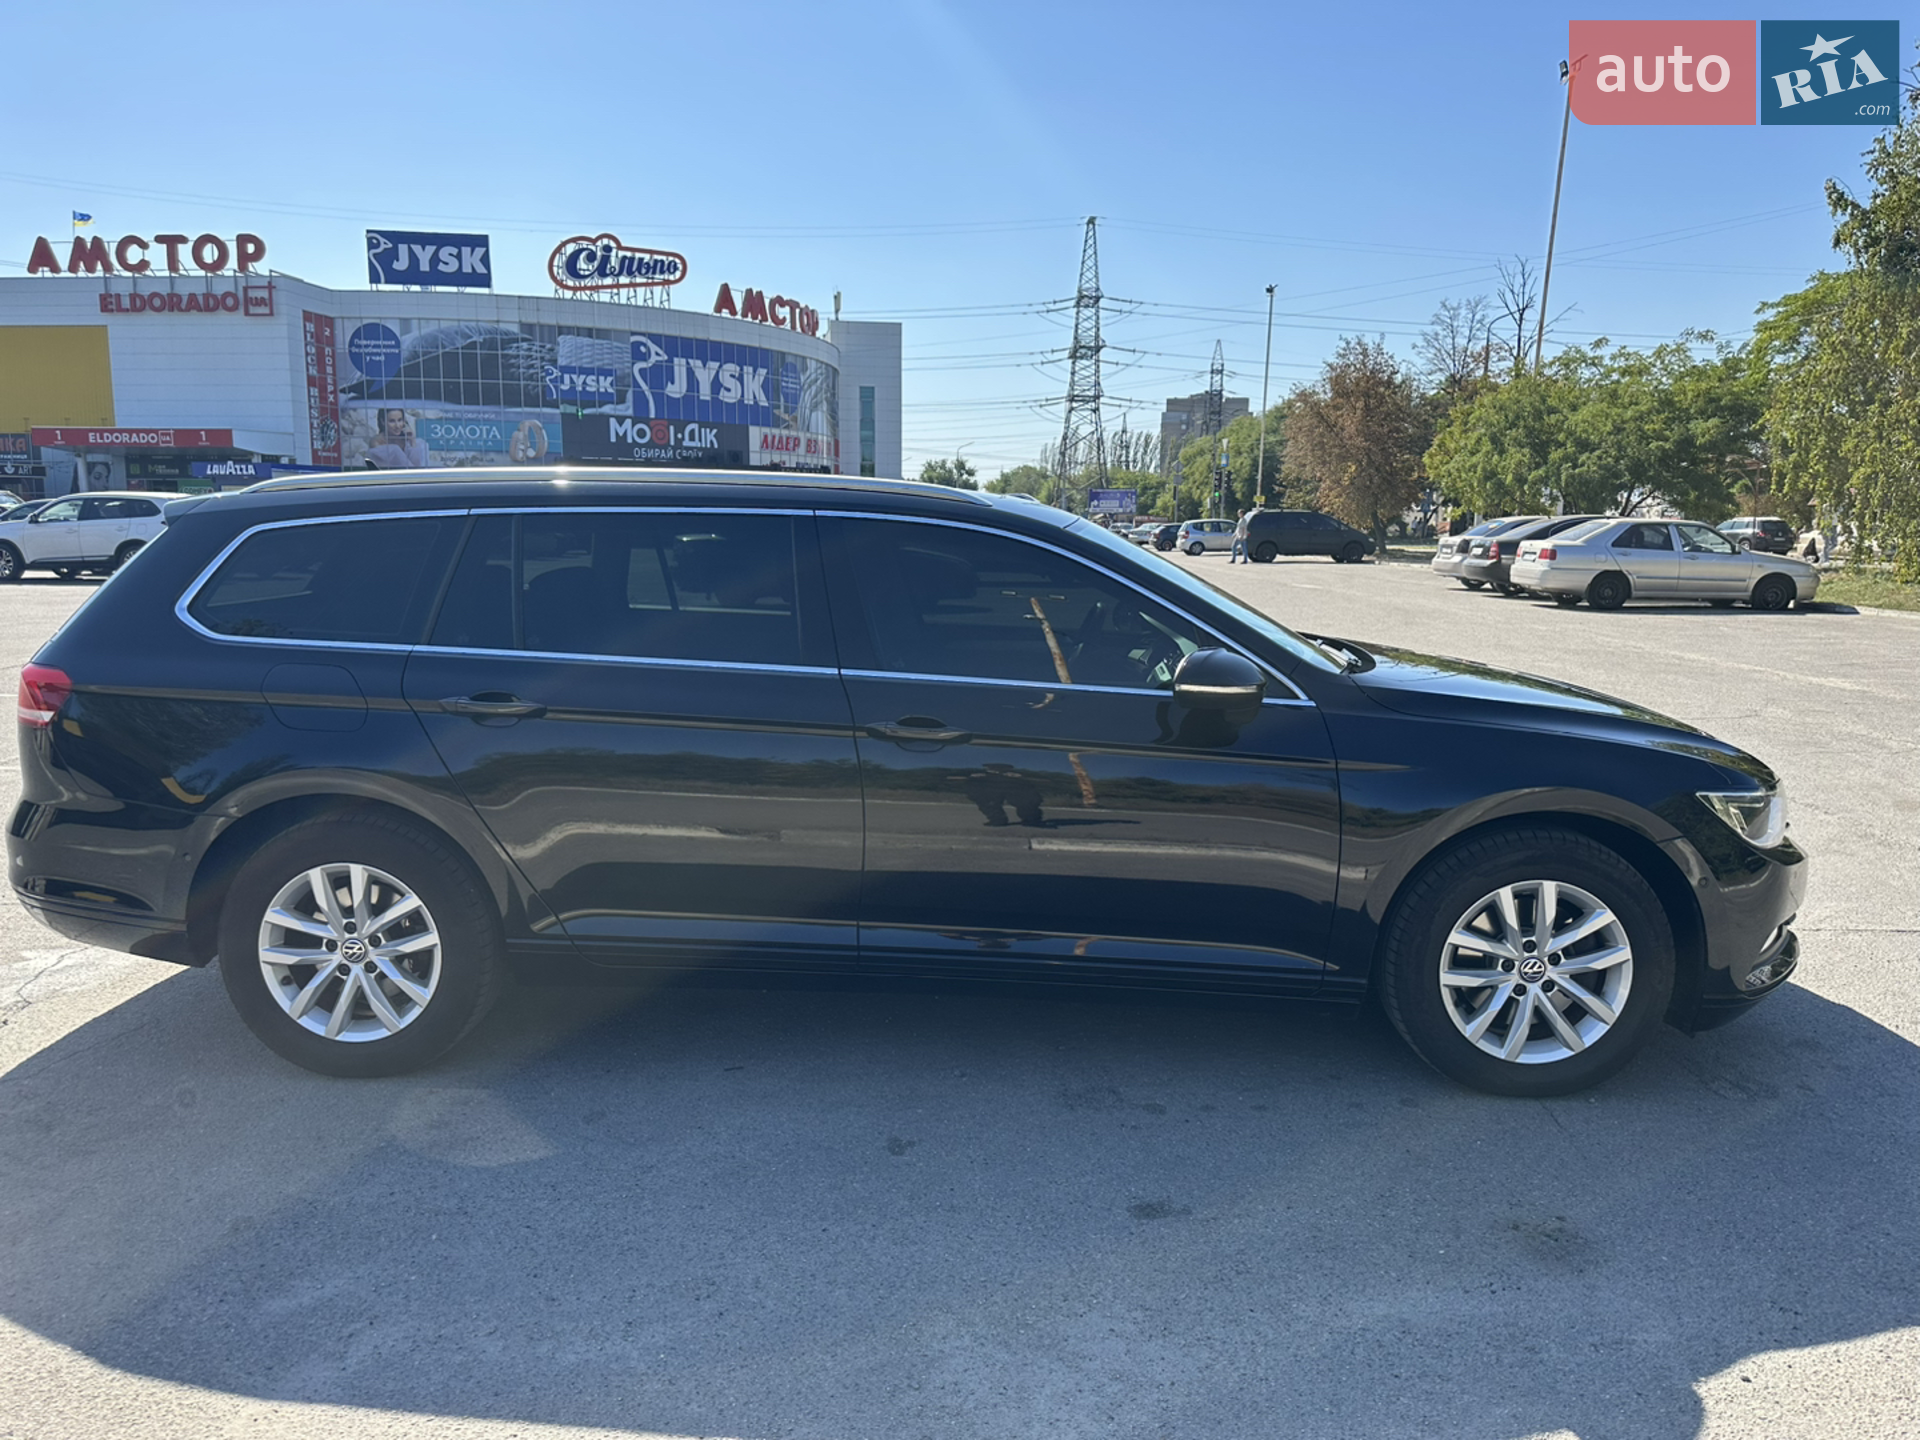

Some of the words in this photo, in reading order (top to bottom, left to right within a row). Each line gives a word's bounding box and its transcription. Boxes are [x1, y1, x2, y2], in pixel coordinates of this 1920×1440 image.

[27, 233, 266, 275] АМСТОР
[391, 243, 488, 274] JYSK
[565, 242, 680, 280] Сільпо
[98, 291, 240, 313] ELDORADO
[560, 373, 615, 393] JYSK
[664, 357, 769, 406] JYSK
[55, 430, 62, 440] 1
[88, 432, 158, 443] ELDORADO
[200, 431, 206, 441] 1
[430, 424, 501, 440] ЗОЛОТА
[634, 447, 674, 459] ОБИРАЙ
[206, 460, 256, 475] LAVAZZA
